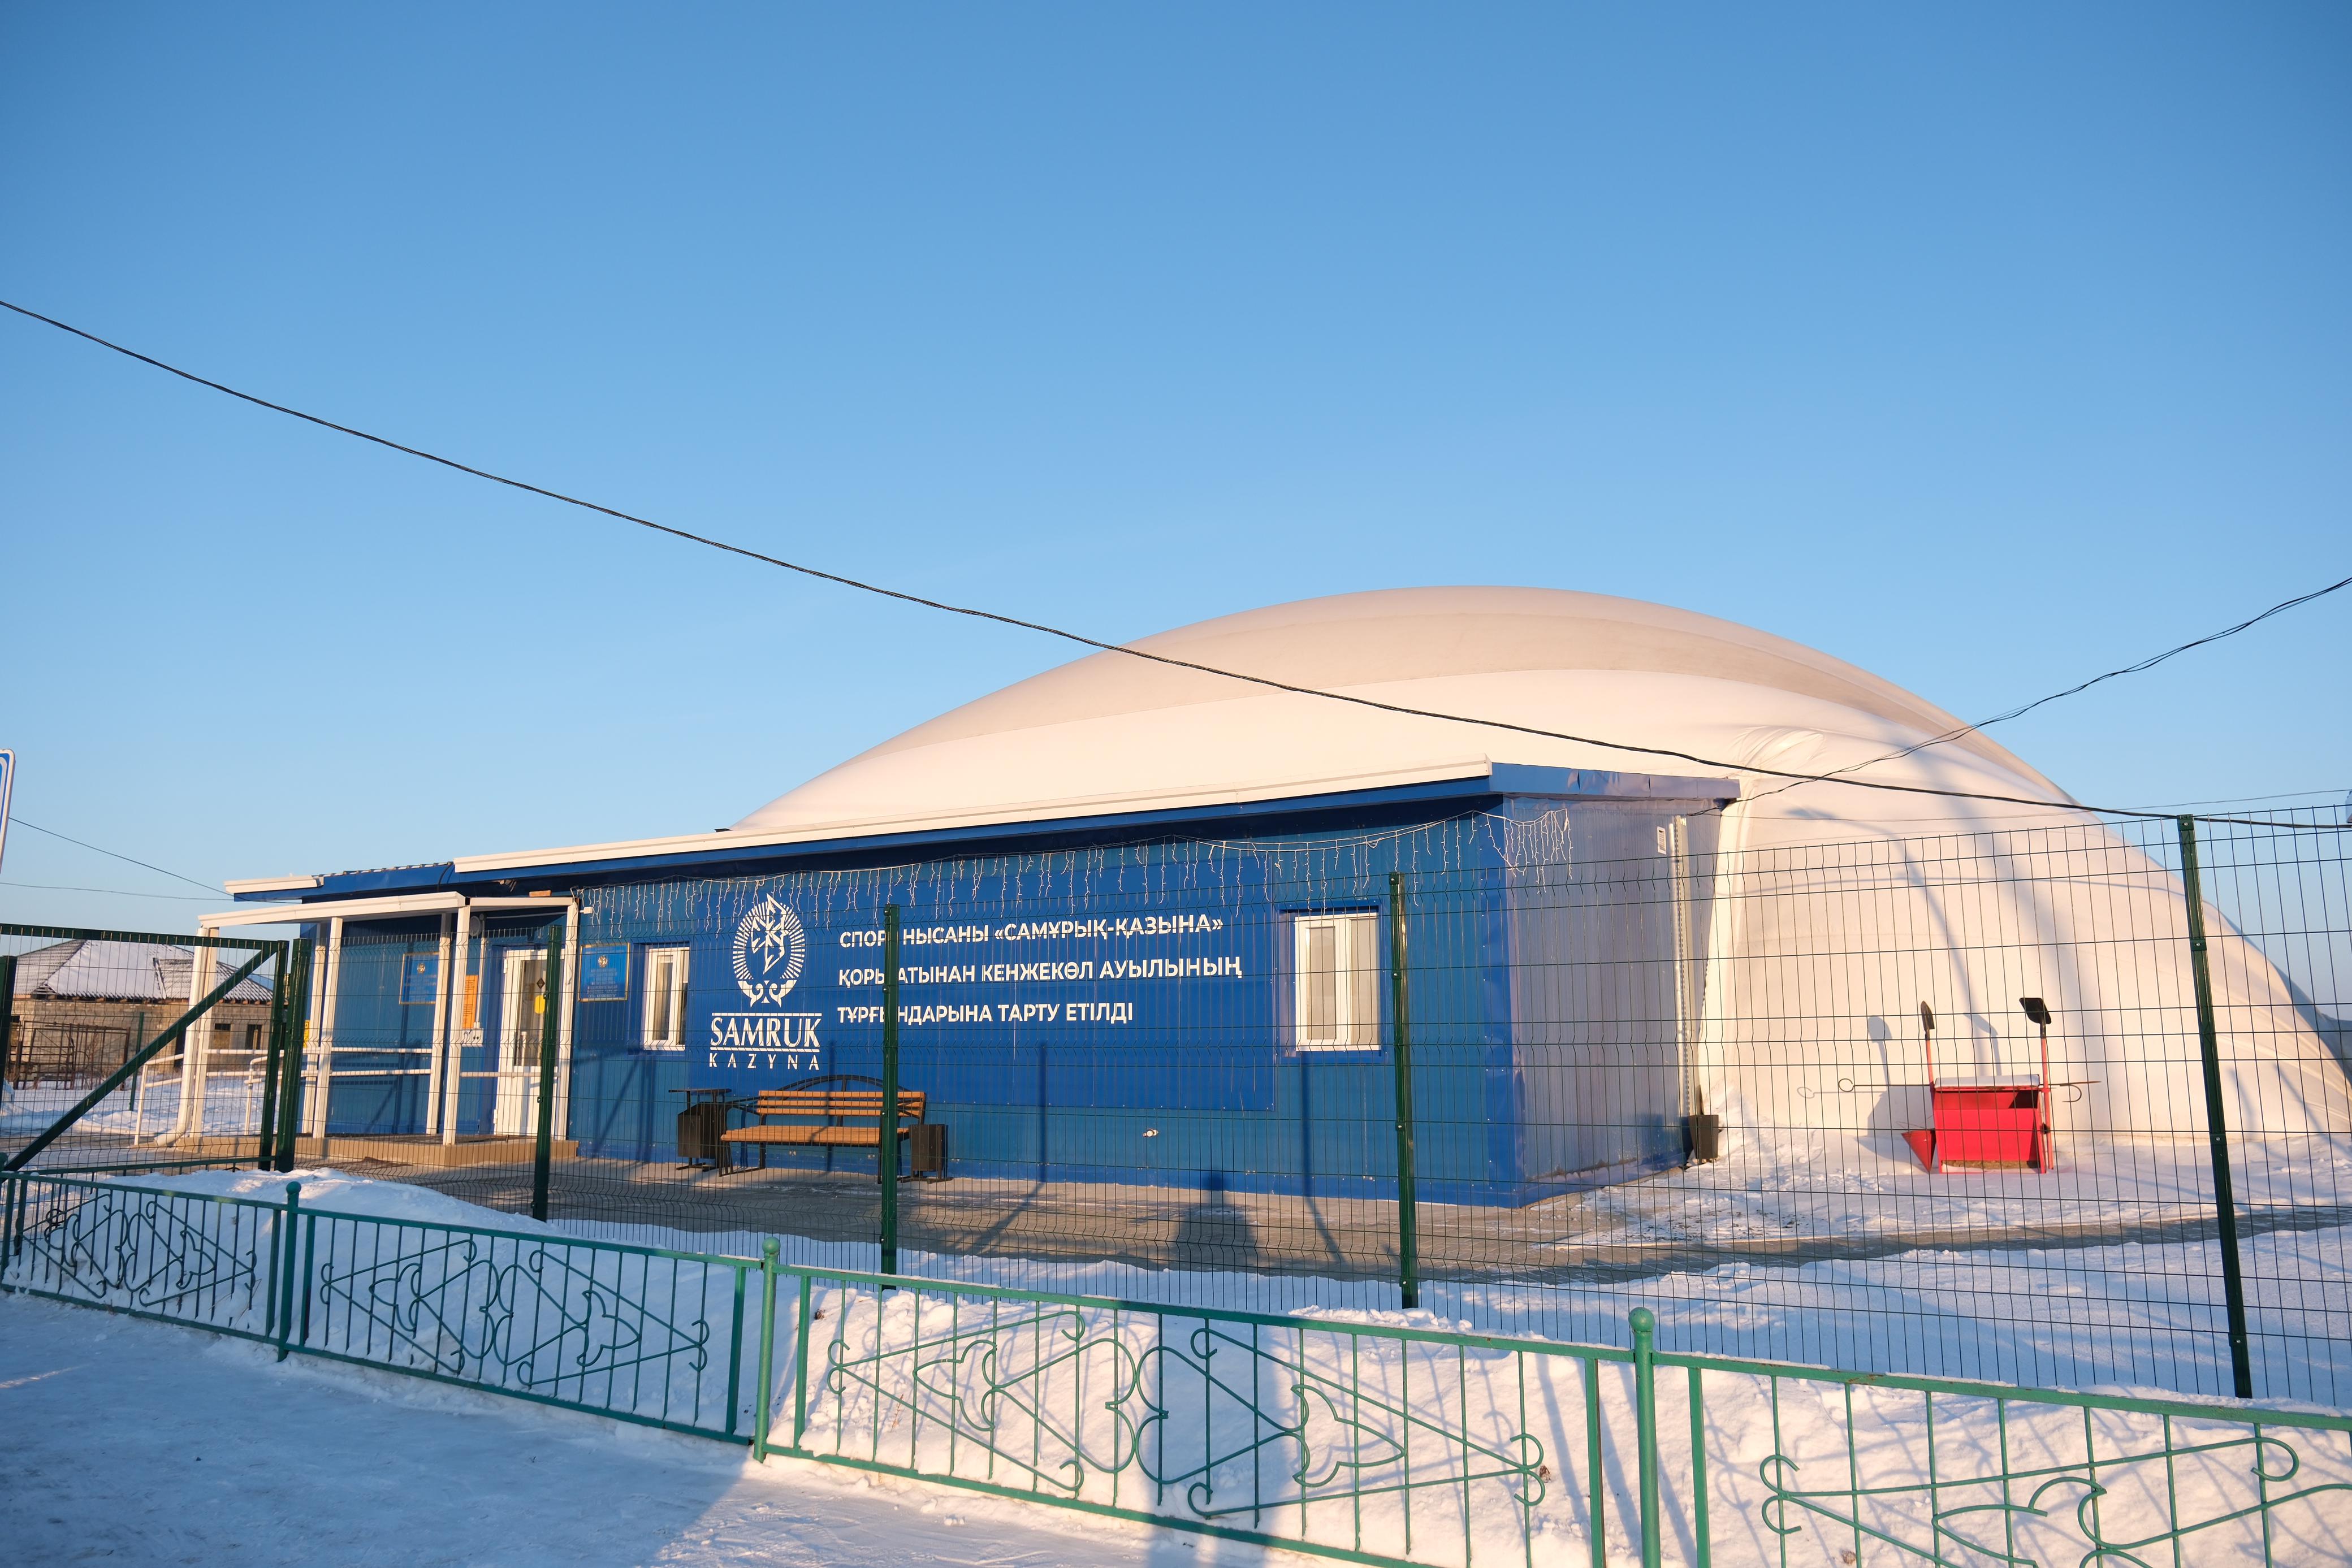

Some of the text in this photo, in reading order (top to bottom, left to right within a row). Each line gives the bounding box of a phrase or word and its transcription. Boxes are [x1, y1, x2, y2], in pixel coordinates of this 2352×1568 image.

[840, 914, 1223, 948] СПОР НЫСАНЫ «САМҰРЫҚ-ҚАЗЫНА»
[982, 961, 1093, 982] КЕНЖЕКӨЛ
[1099, 956, 1242, 978] АУЫЛЫНЫҢ
[997, 1004, 1060, 1022] ТАРТУ
[1066, 1002, 1132, 1024] ЕТІЛДІ
[710, 1017, 822, 1047] SAMRUK
[709, 1052, 819, 1070] KAZYNA
